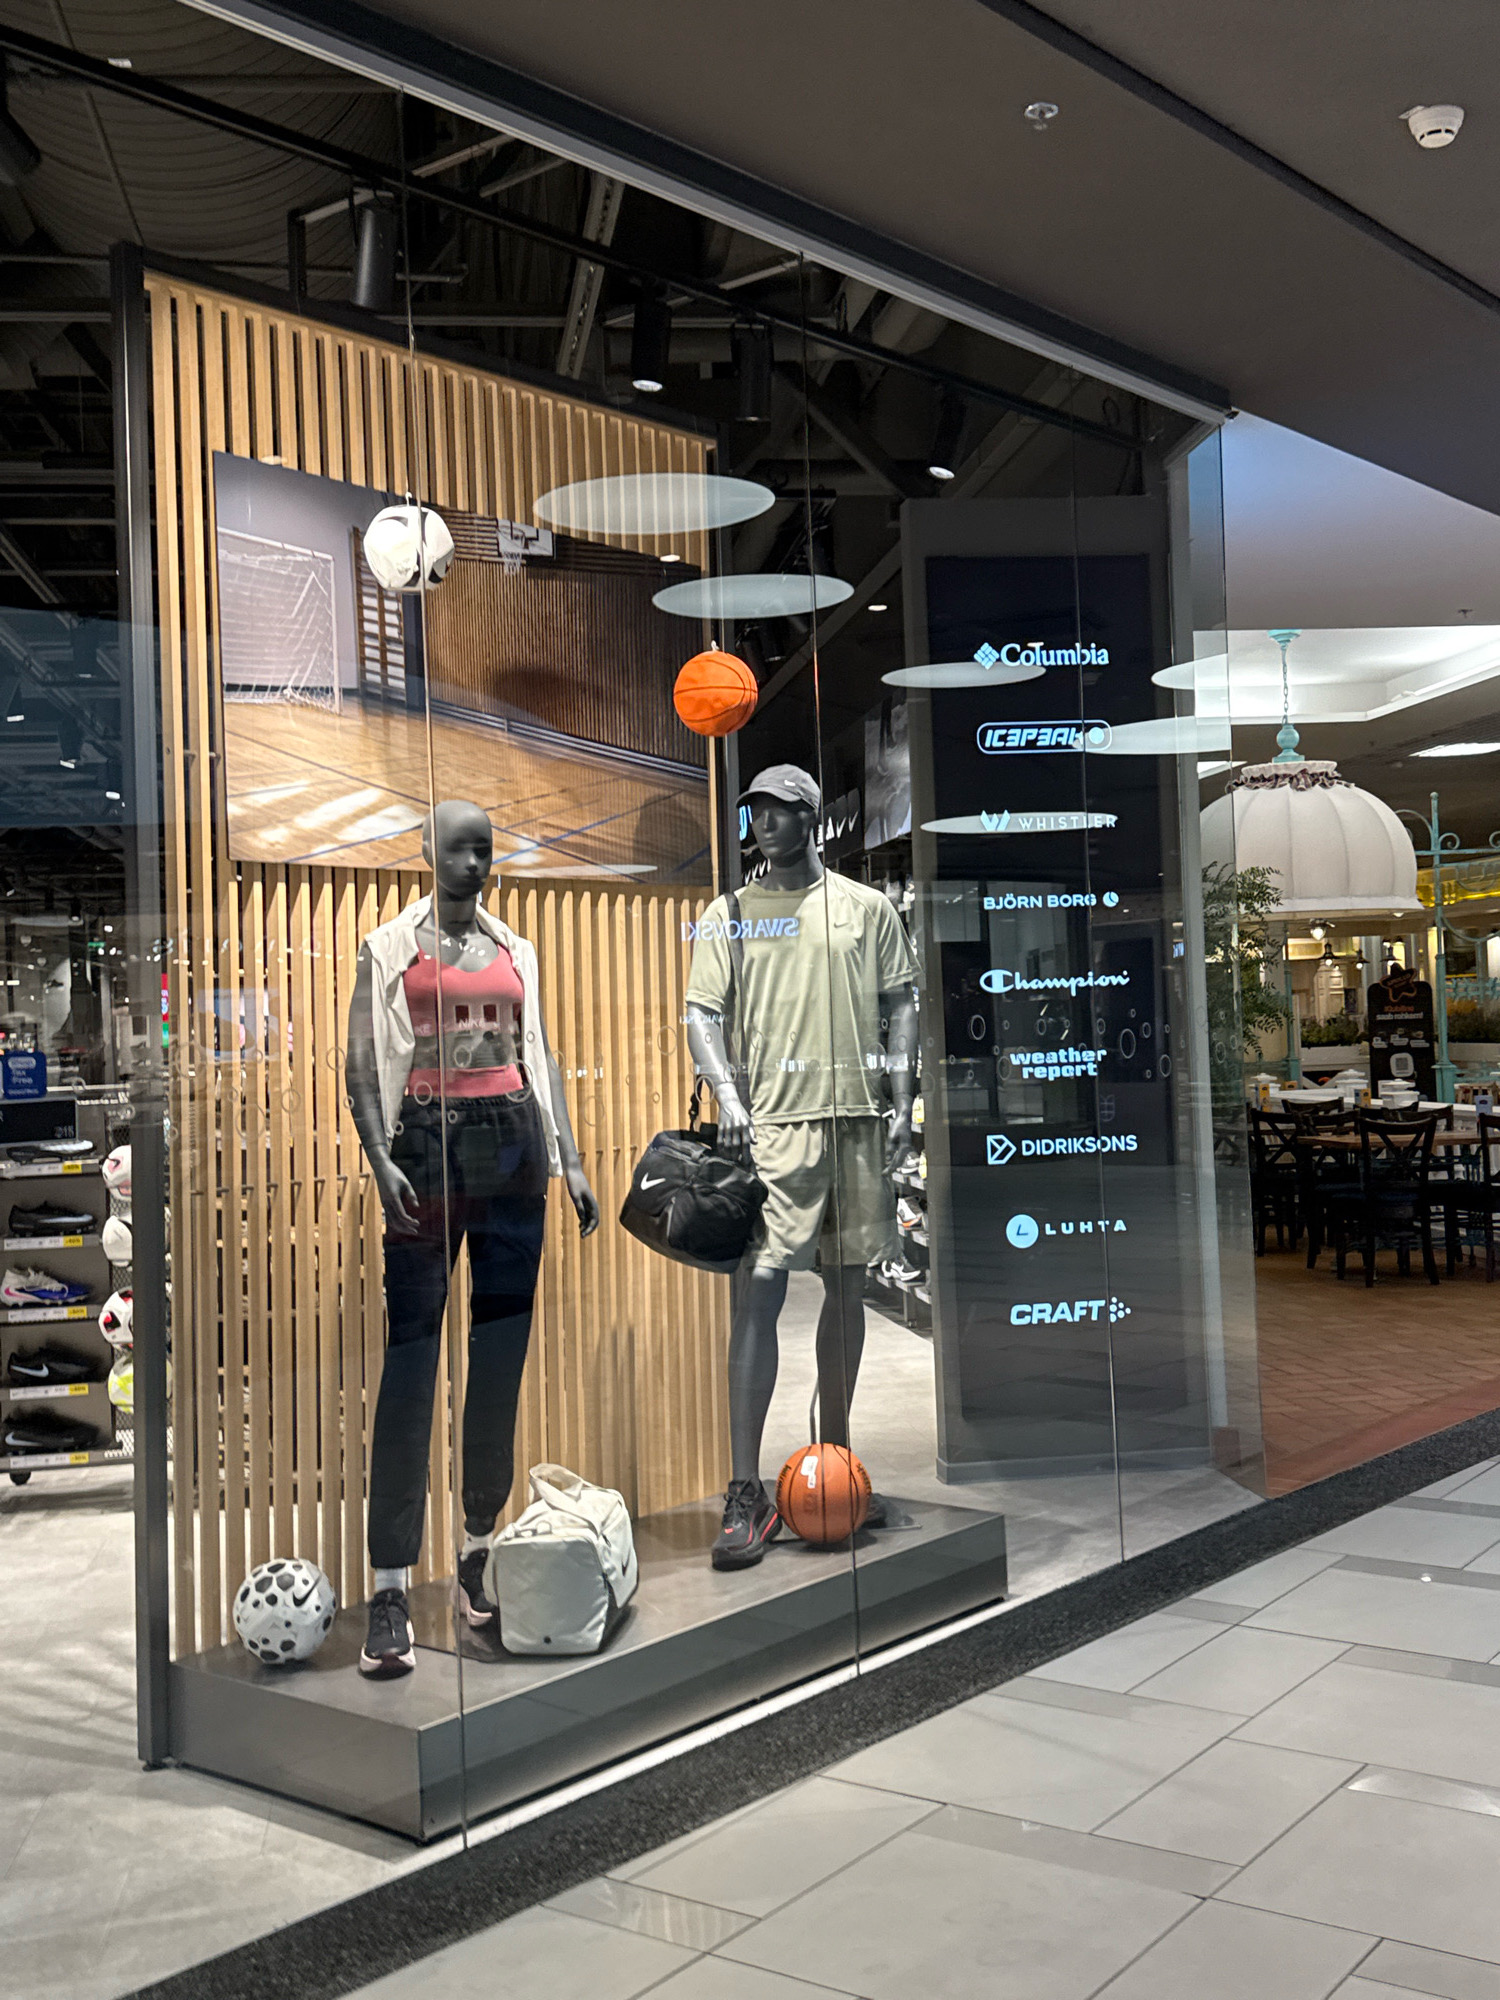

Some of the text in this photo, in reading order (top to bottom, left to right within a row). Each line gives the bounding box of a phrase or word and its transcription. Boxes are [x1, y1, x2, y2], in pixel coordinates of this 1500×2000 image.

[1000, 642, 1110, 667] Columbia
[1018, 814, 1117, 830] WHISTLER
[983, 892, 1097, 910] BJÖRN BORG
[979, 968, 1130, 997] Champion
[1009, 1046, 1108, 1066] weather
[1022, 1063, 1099, 1081] report
[1021, 1134, 1138, 1156] DIDRIKSONS
[1044, 1219, 1127, 1235] LUHTA
[1010, 1299, 1106, 1326] CRAFT
